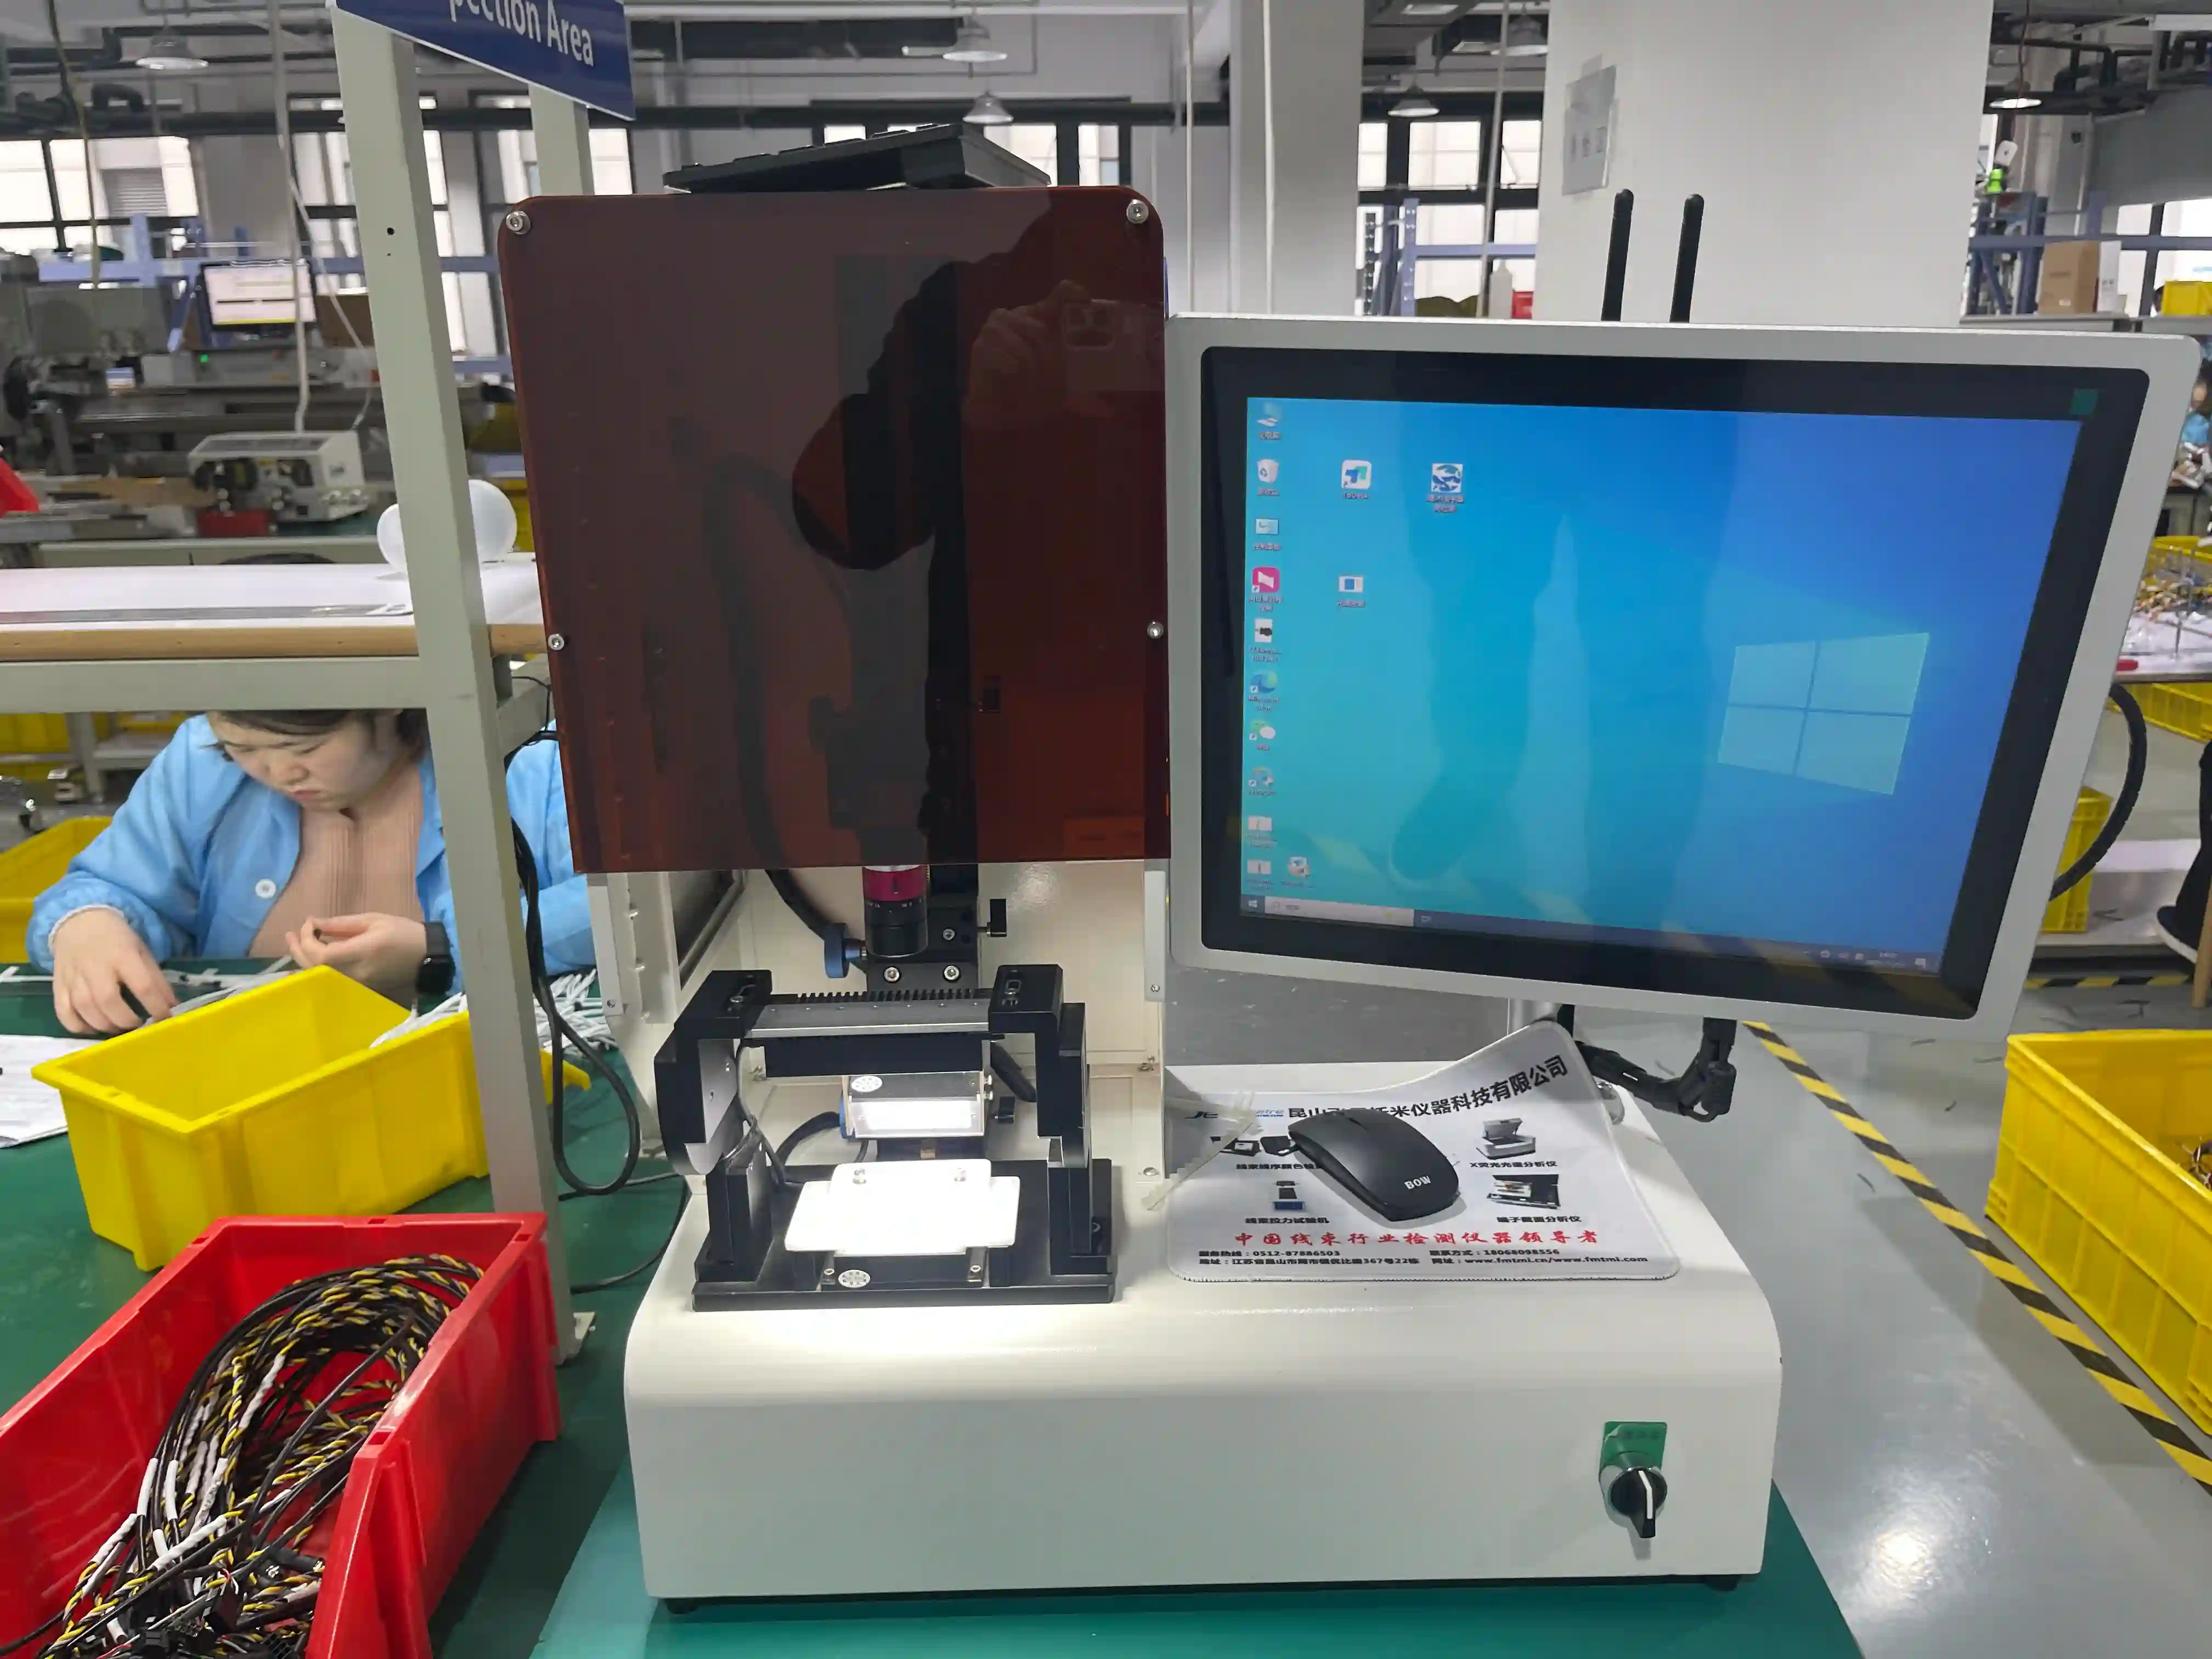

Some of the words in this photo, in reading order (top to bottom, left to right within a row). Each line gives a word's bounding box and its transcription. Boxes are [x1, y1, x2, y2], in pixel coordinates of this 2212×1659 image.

[548, 0, 594, 67] Area
[1288, 1054, 1568, 1118] 昆山米仪器科技有限公司
[1404, 1175, 1431, 1190] BOW
[1235, 1229, 1598, 1246] 中国线束行业检测仪器领导者
